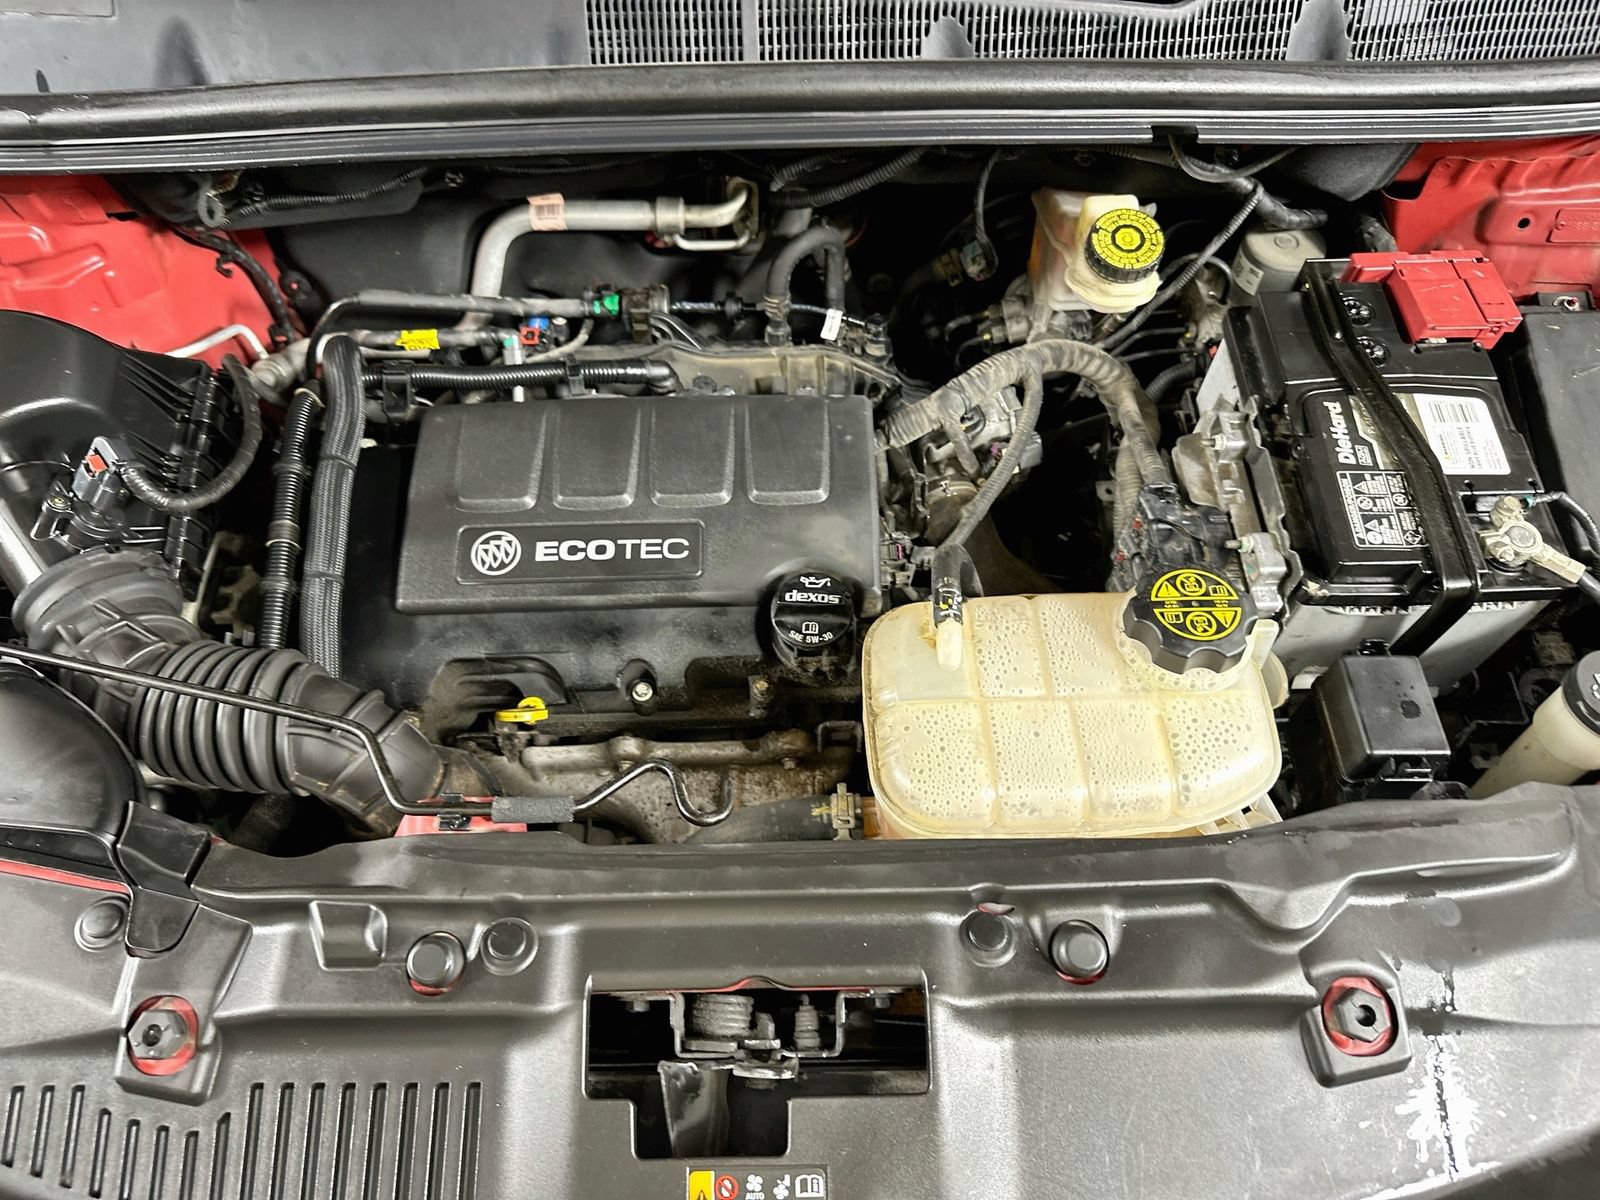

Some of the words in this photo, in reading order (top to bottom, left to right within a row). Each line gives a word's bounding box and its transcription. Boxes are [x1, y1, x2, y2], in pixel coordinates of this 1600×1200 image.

[1324, 401, 1357, 464] DieHard
[535, 538, 690, 562] ECOTEC
[785, 590, 842, 604] dexos
[789, 630, 804, 642] SAE
[805, 631, 834, 644] 5W-30
[745, 1191, 765, 1200] AUTO
